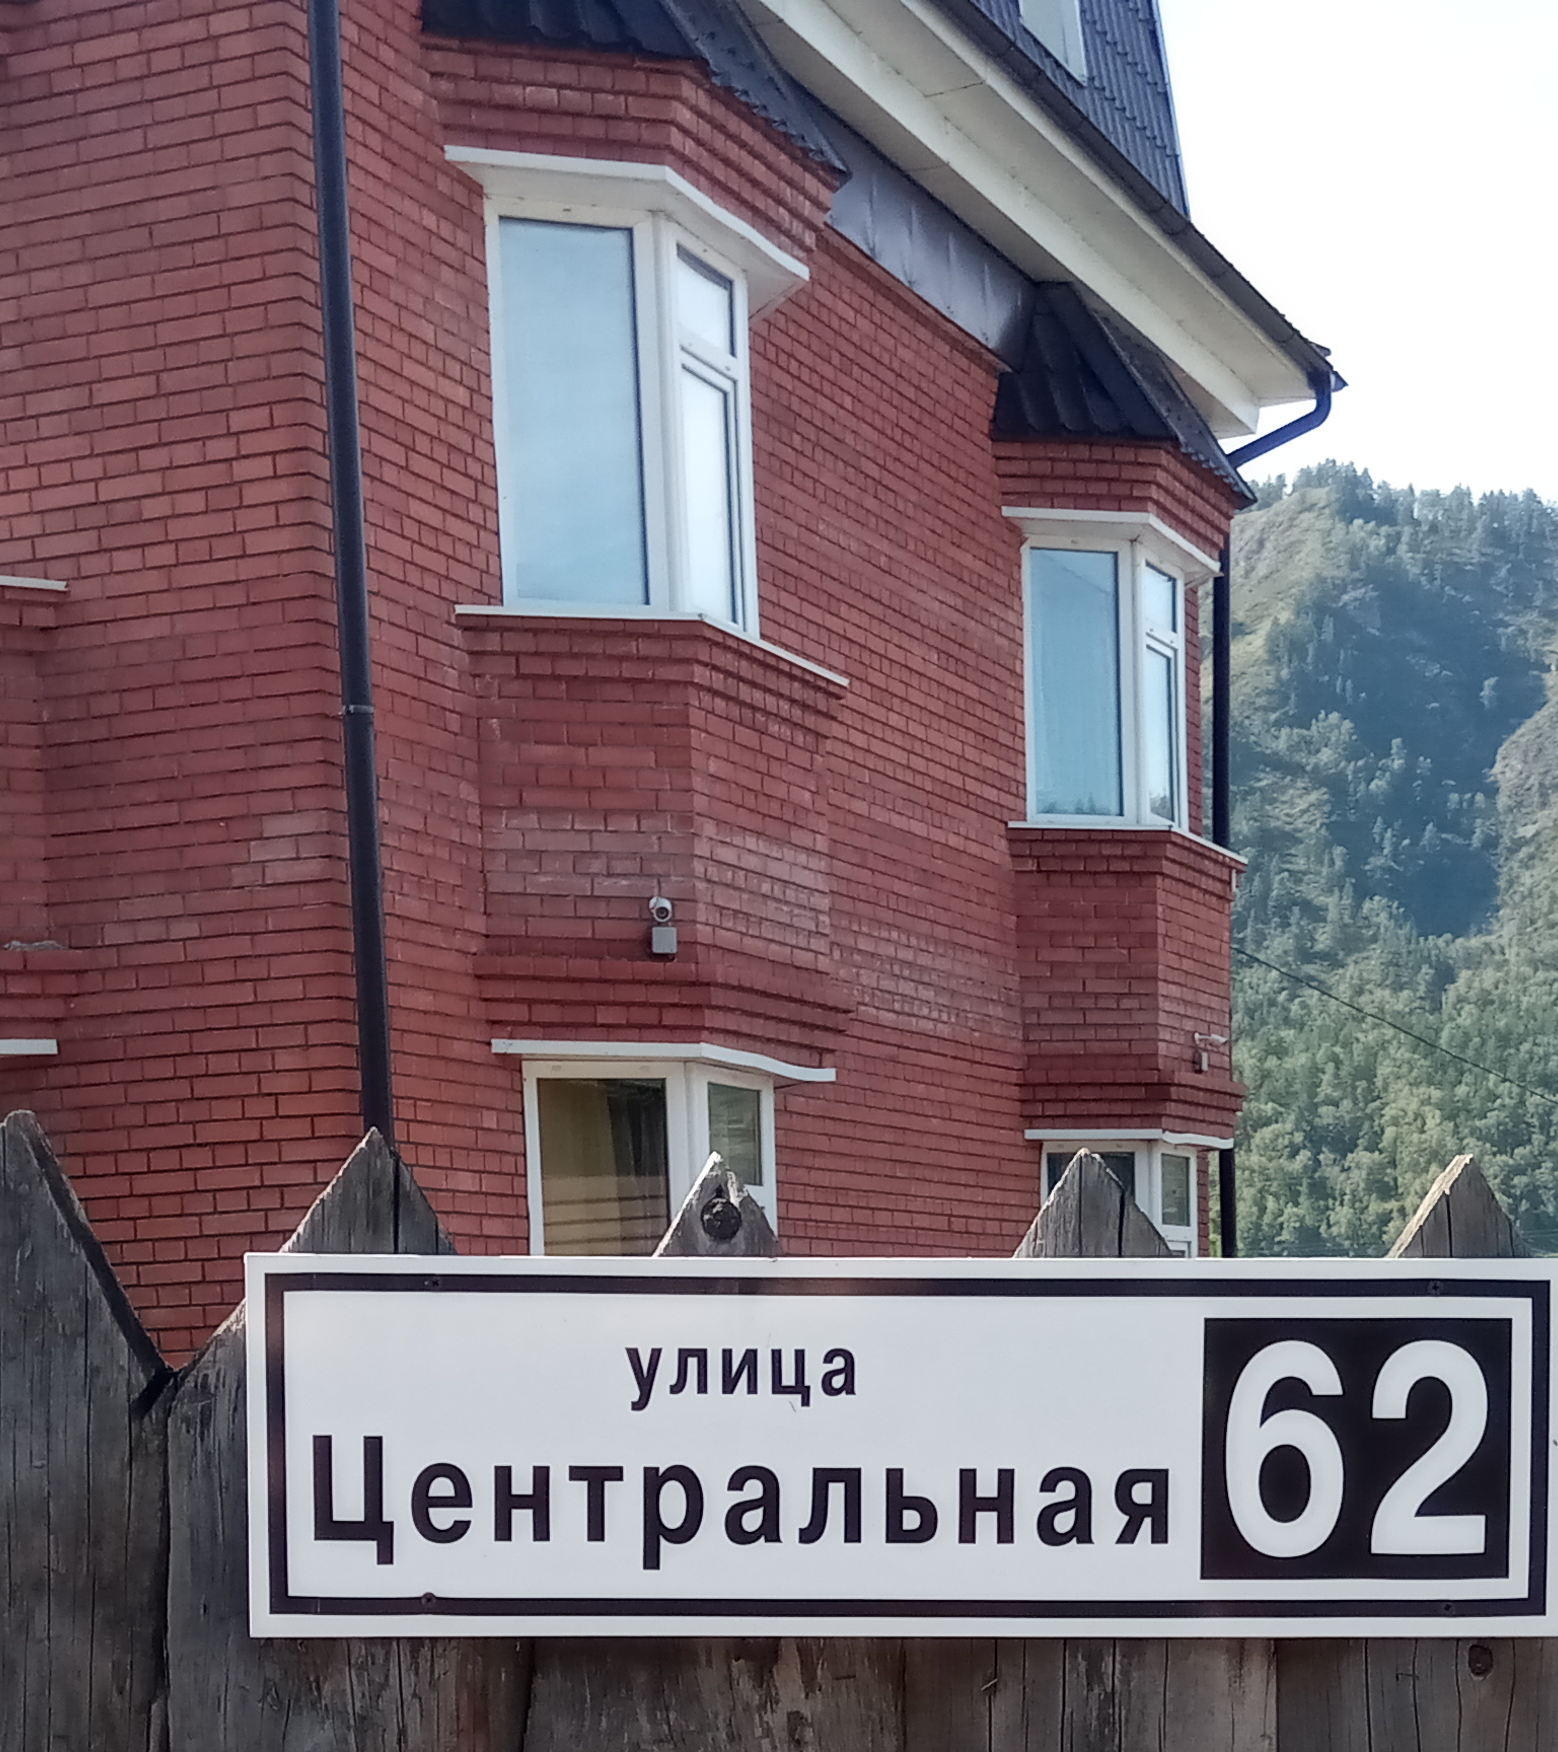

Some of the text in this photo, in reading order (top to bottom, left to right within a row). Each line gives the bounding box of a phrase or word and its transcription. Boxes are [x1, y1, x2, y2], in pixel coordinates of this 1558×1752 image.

[624, 1346, 857, 1412] улица
[311, 1433, 1171, 1571] Центральная
[1224, 1338, 1489, 1559] 62
